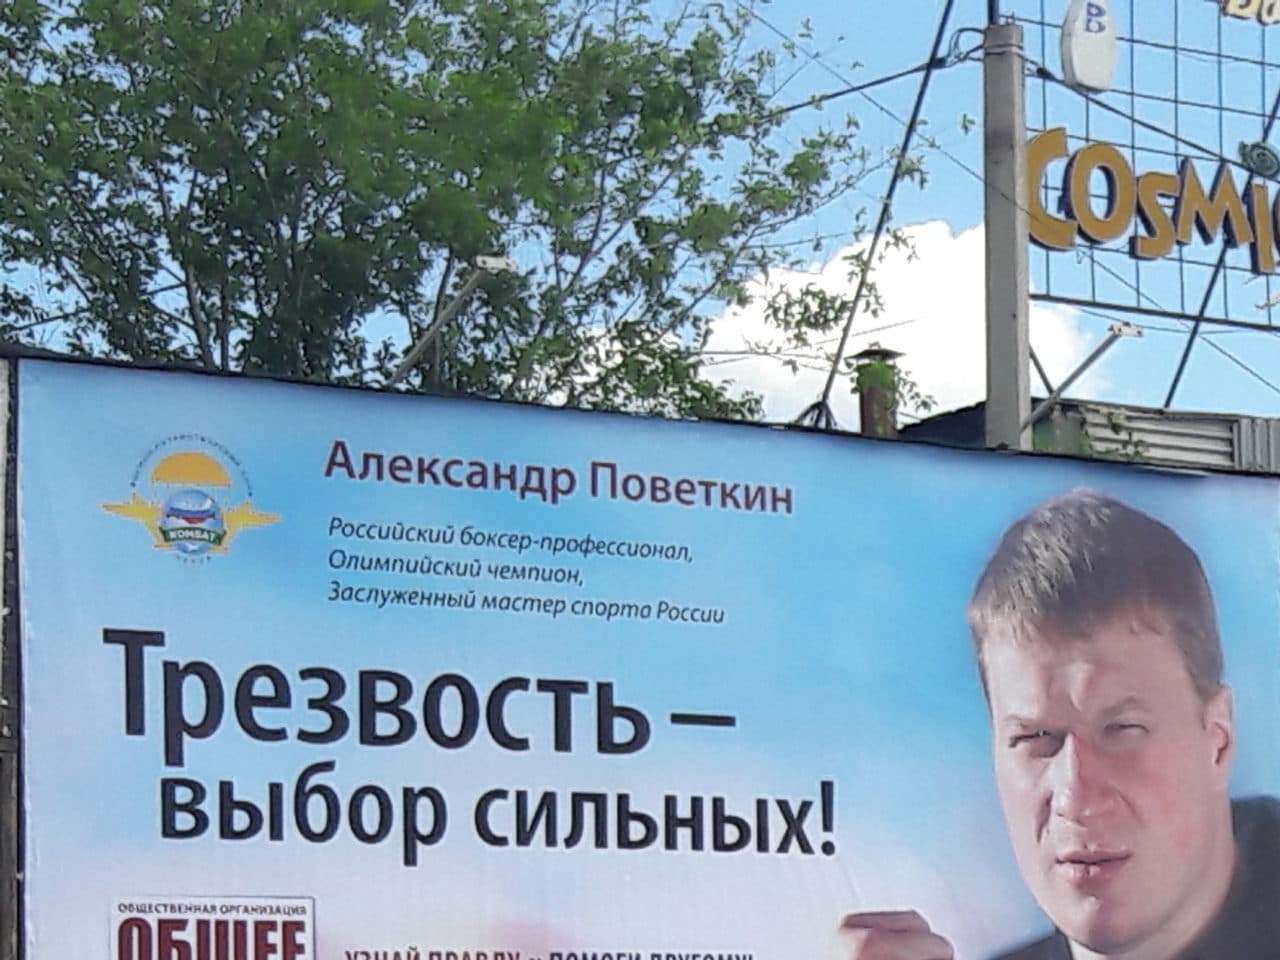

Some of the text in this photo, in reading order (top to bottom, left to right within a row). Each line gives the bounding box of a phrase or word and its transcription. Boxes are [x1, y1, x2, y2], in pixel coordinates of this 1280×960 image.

[324, 440, 576, 505] Александр
[590, 461, 793, 514] Поветкин
[328, 516, 693, 564] Российский боксер-профессионал,
[328, 549, 584, 587] Олимпийский чемпион,
[327, 580, 725, 624] Заслуженный мастер спорта России
[102, 628, 651, 767] Трезвость
[159, 760, 836, 867] выбор сильных!
[118, 902, 307, 917] ОБЩЕСТВЕННАЯ ОРГАНИЗАЦИЯ
